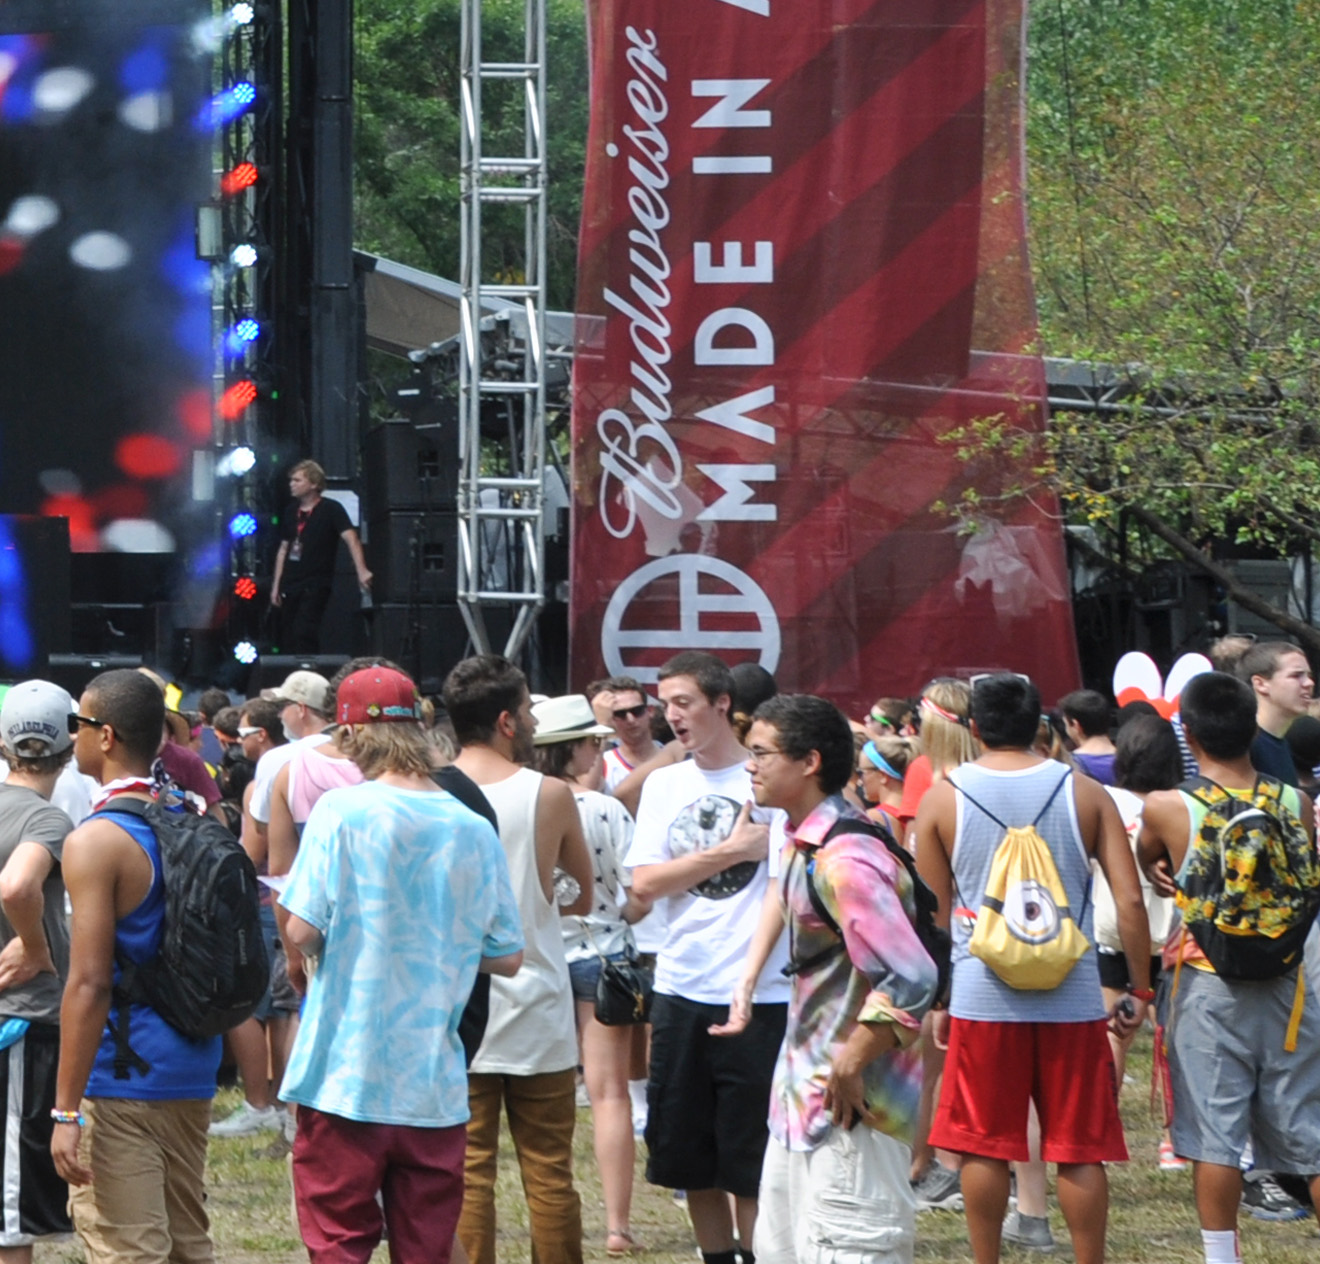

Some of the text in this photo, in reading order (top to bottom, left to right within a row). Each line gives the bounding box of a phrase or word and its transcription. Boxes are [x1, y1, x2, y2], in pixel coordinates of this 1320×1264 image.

[691, 79, 773, 174] IN
[599, 26, 683, 538] Budweiser
[693, 241, 778, 522] MADE
